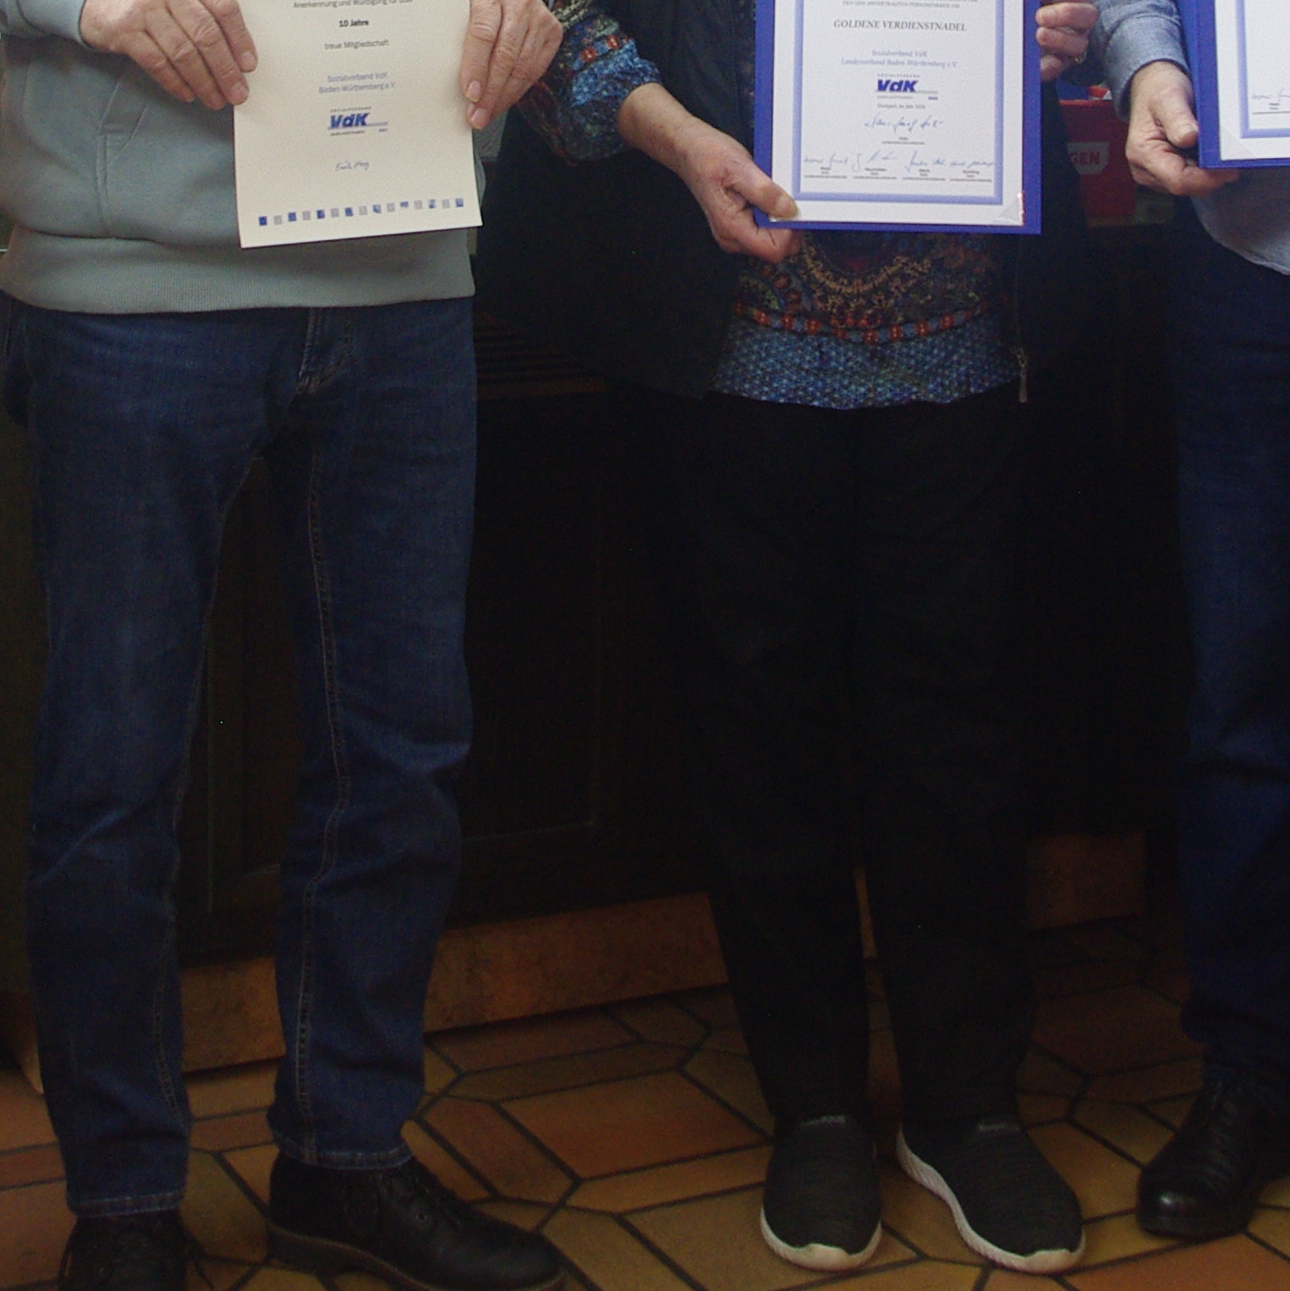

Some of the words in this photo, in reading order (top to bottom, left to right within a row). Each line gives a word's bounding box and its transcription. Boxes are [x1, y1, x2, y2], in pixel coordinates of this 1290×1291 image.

[350, 19, 369, 27] Jahre
[833, 19, 880, 29] GOLDENE
[883, 20, 967, 31] VERDIENSTNADEL
[877, 79, 919, 92] VdK
[330, 112, 370, 128] VdK
